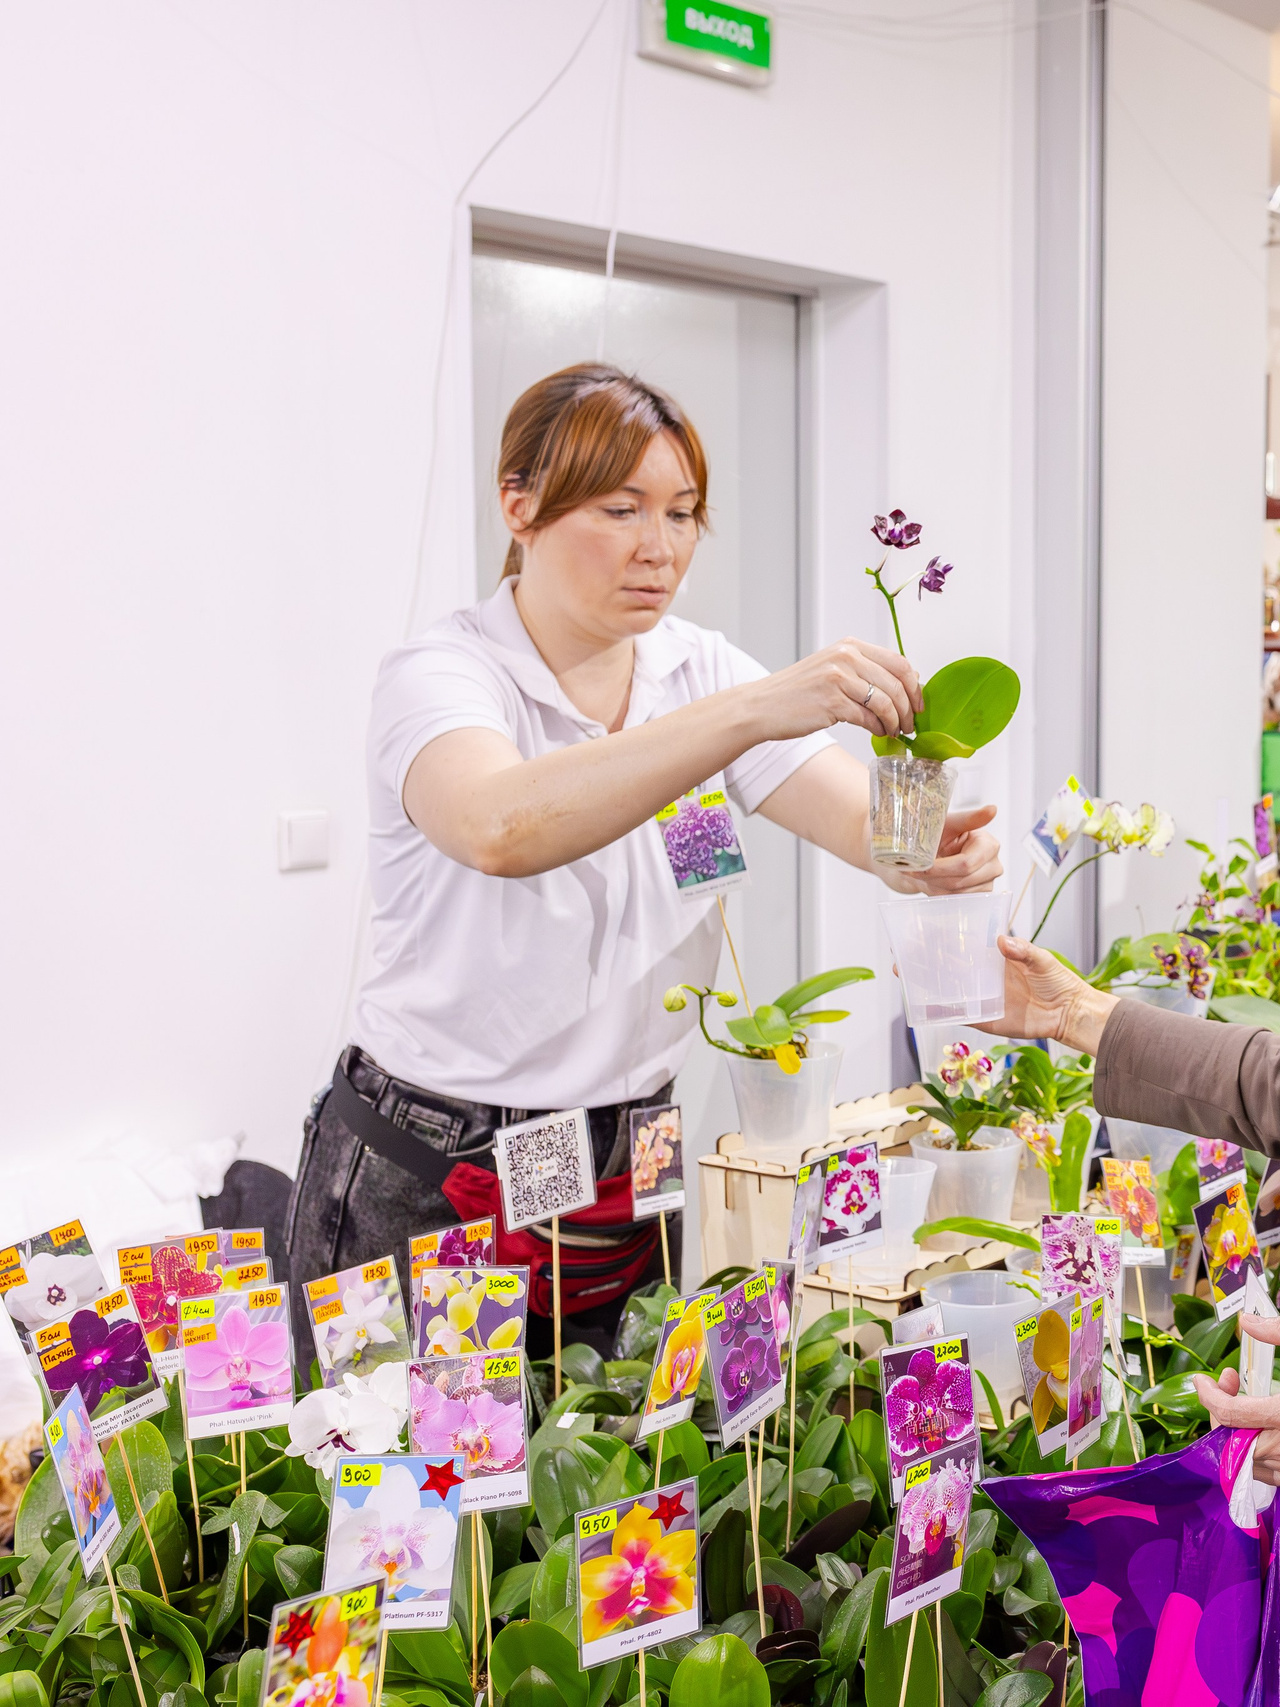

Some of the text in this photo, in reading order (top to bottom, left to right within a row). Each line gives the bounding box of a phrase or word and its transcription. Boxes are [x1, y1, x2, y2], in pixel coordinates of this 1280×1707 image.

[685, 7, 755, 51] ВЫХОД
[1096, 1222, 1118, 1231] 1800
[54, 1227, 77, 1244] 1700
[187, 1239, 215, 1253] 1950
[238, 1266, 264, 1281] 2250
[364, 1266, 388, 1281] 1750
[488, 1279, 515, 1290] 3000
[746, 1279, 765, 1297] 3500
[100, 1294, 123, 1314] 1750
[252, 1292, 278, 1307] 1950
[1016, 1319, 1037, 1338] 2300
[936, 1345, 961, 1359] 2700
[157, 1362, 179, 1372] peloric
[486, 1360, 517, 1376] 1590
[92, 1397, 154, 1433] heng Min Jacaranda
[121, 1412, 141, 1426] FA316
[209, 1421, 226, 1429] Phal.
[343, 1467, 372, 1483] 900
[907, 1467, 929, 1484] 2700
[481, 1494, 498, 1502] Piano
[499, 1489, 523, 1499] PF-5098
[582, 1515, 611, 1535] 950
[384, 1610, 444, 1620] Platinum PF-5317
[620, 1628, 663, 1647] Phal. PF-4802
